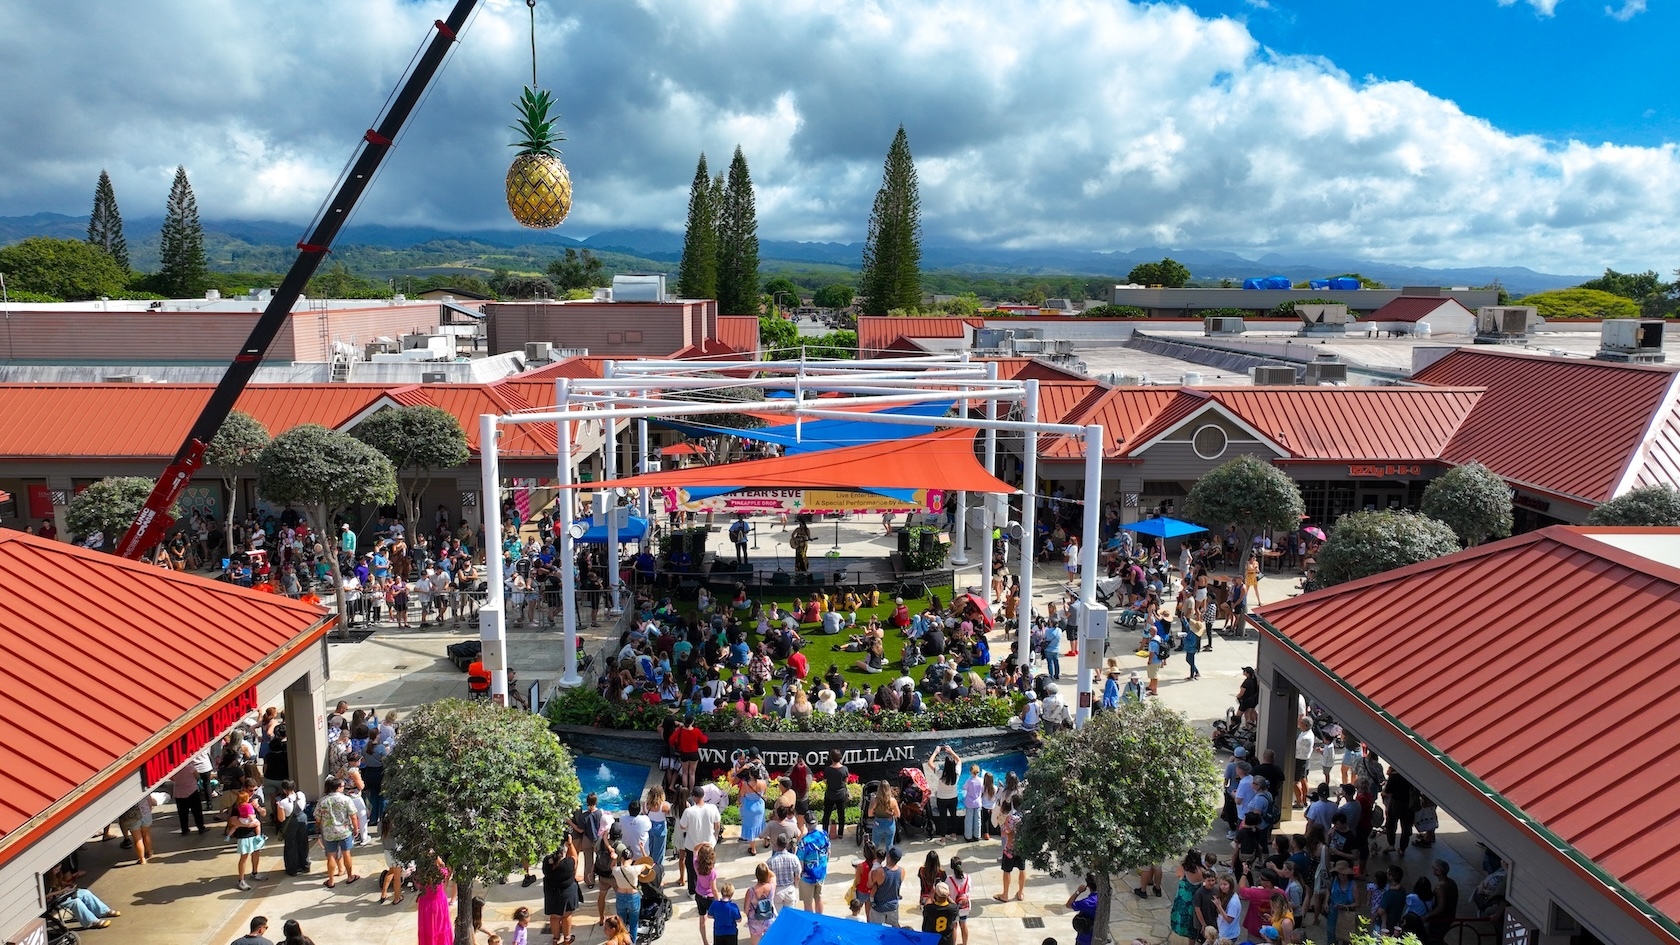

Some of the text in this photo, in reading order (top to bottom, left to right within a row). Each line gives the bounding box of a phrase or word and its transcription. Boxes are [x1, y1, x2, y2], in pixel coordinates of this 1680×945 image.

[781, 490, 801, 498] EVE
[147, 720, 210, 788] MILILANI
[697, 748, 727, 764] WN
[805, 751, 829, 766] OF
[840, 745, 915, 765] MILILANI
[935, 916, 948, 933] 8
